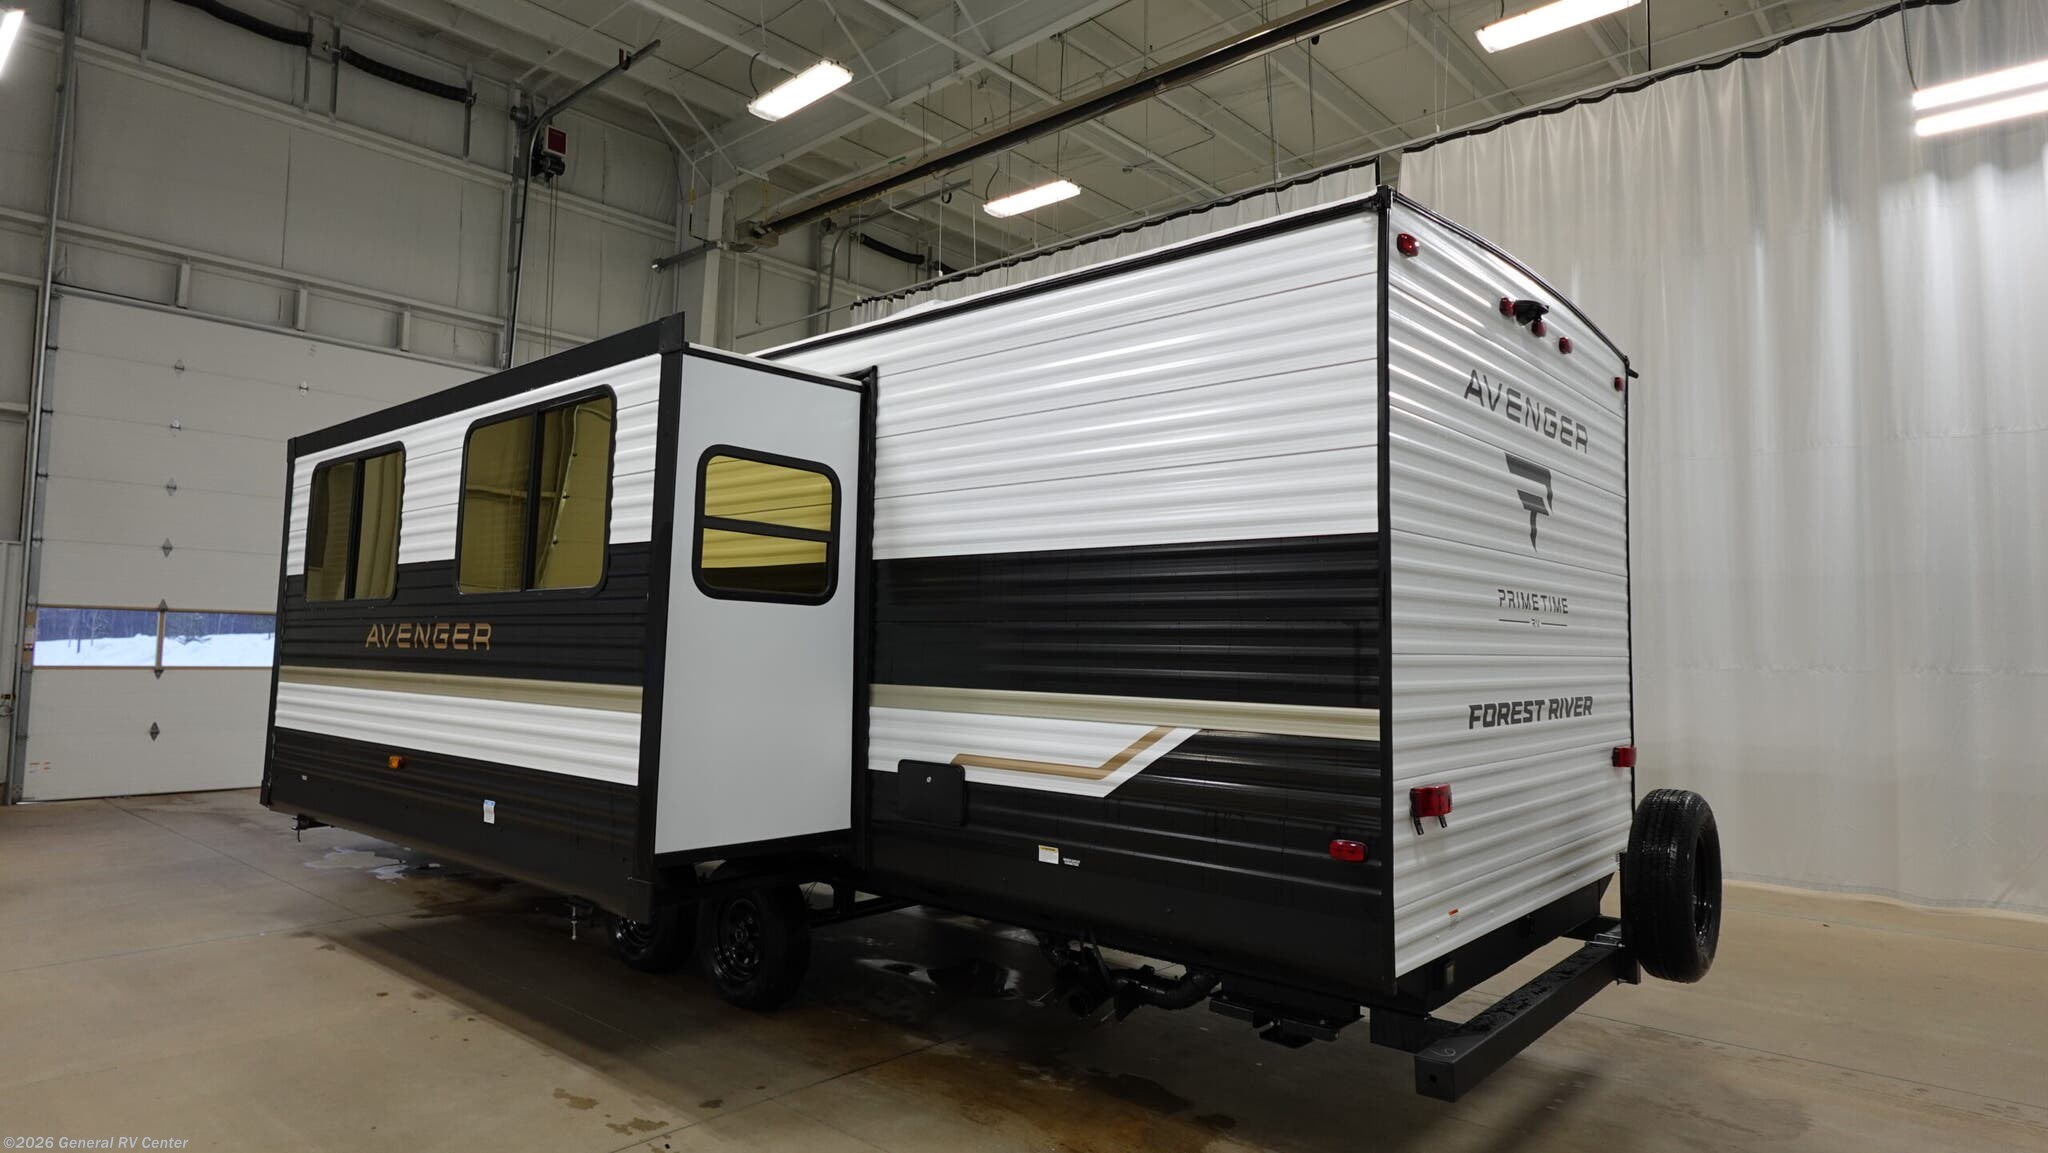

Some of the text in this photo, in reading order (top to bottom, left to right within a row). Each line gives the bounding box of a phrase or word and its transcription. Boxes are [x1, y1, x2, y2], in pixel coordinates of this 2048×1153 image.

[1464, 369, 1588, 454] AVENGER
[365, 622, 492, 651] AVENGER
[1468, 696, 1594, 730] FOREST RIVER
